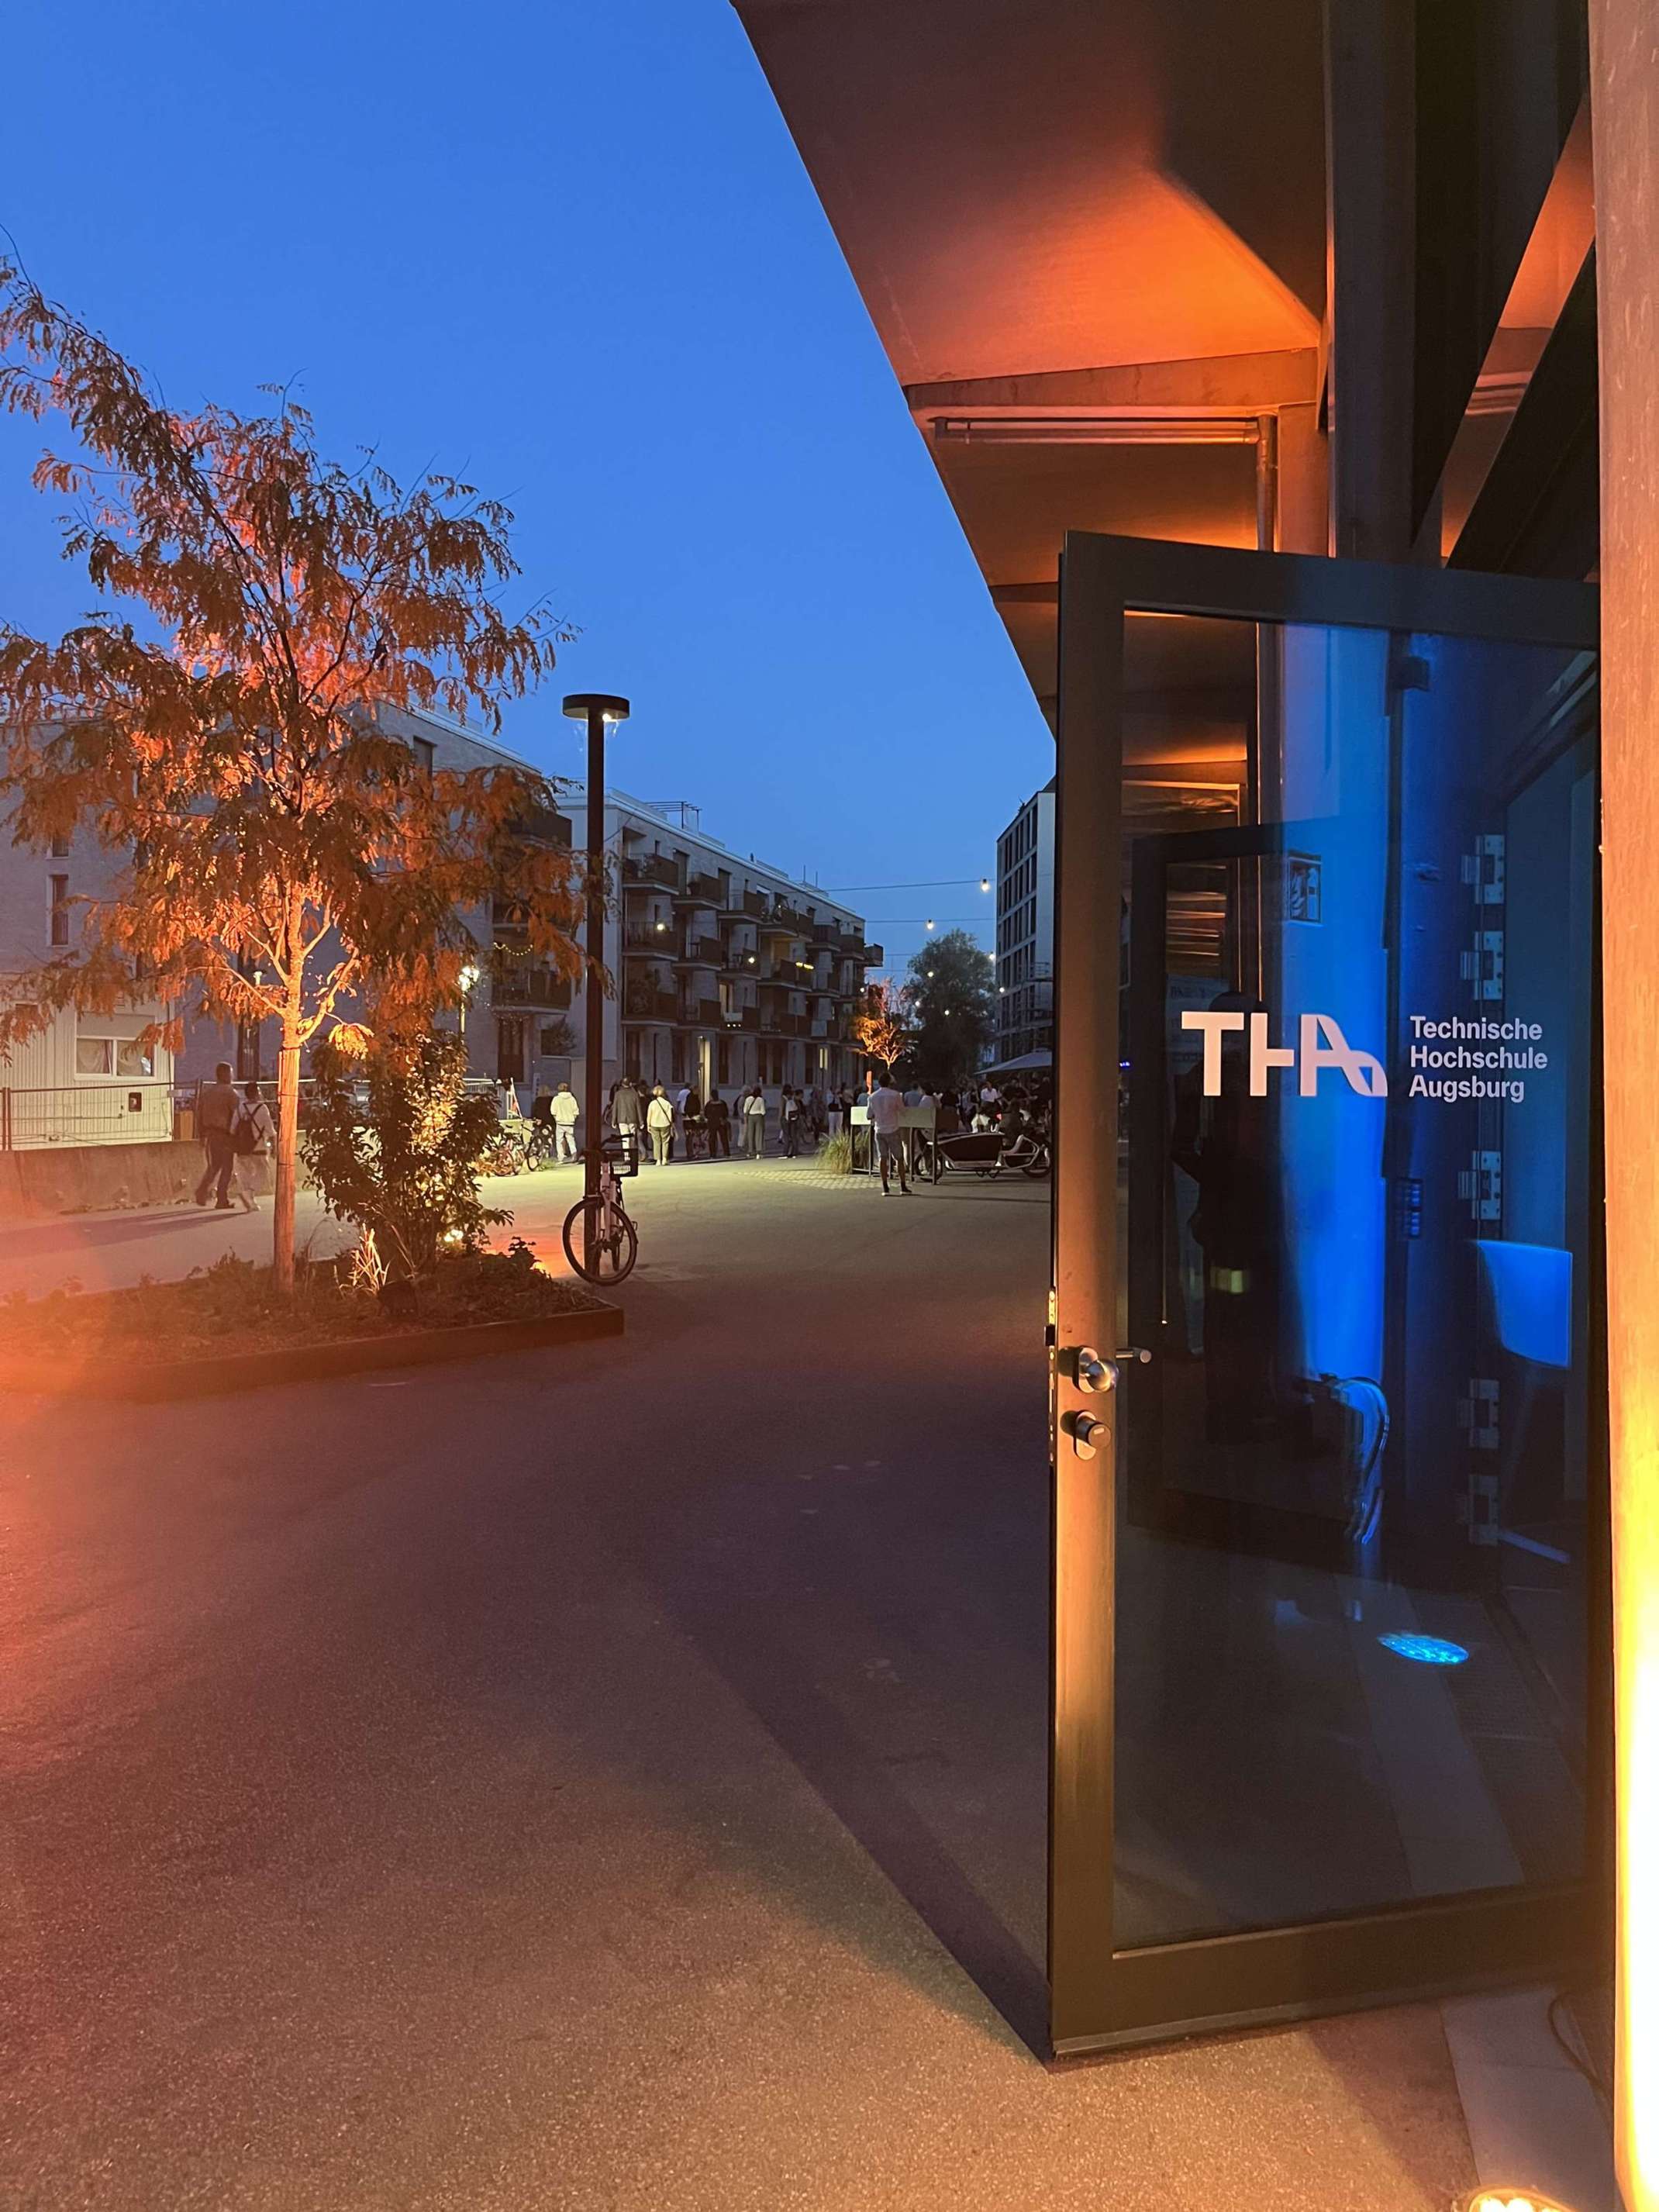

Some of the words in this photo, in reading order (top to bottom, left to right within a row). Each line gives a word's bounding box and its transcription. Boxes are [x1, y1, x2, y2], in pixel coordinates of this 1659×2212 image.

[1409, 1015, 1543, 1040] Technische
[1181, 1011, 1388, 1097] THA
[1409, 1045, 1549, 1071] Hochschule
[1408, 1075, 1526, 1103] Augsburg
